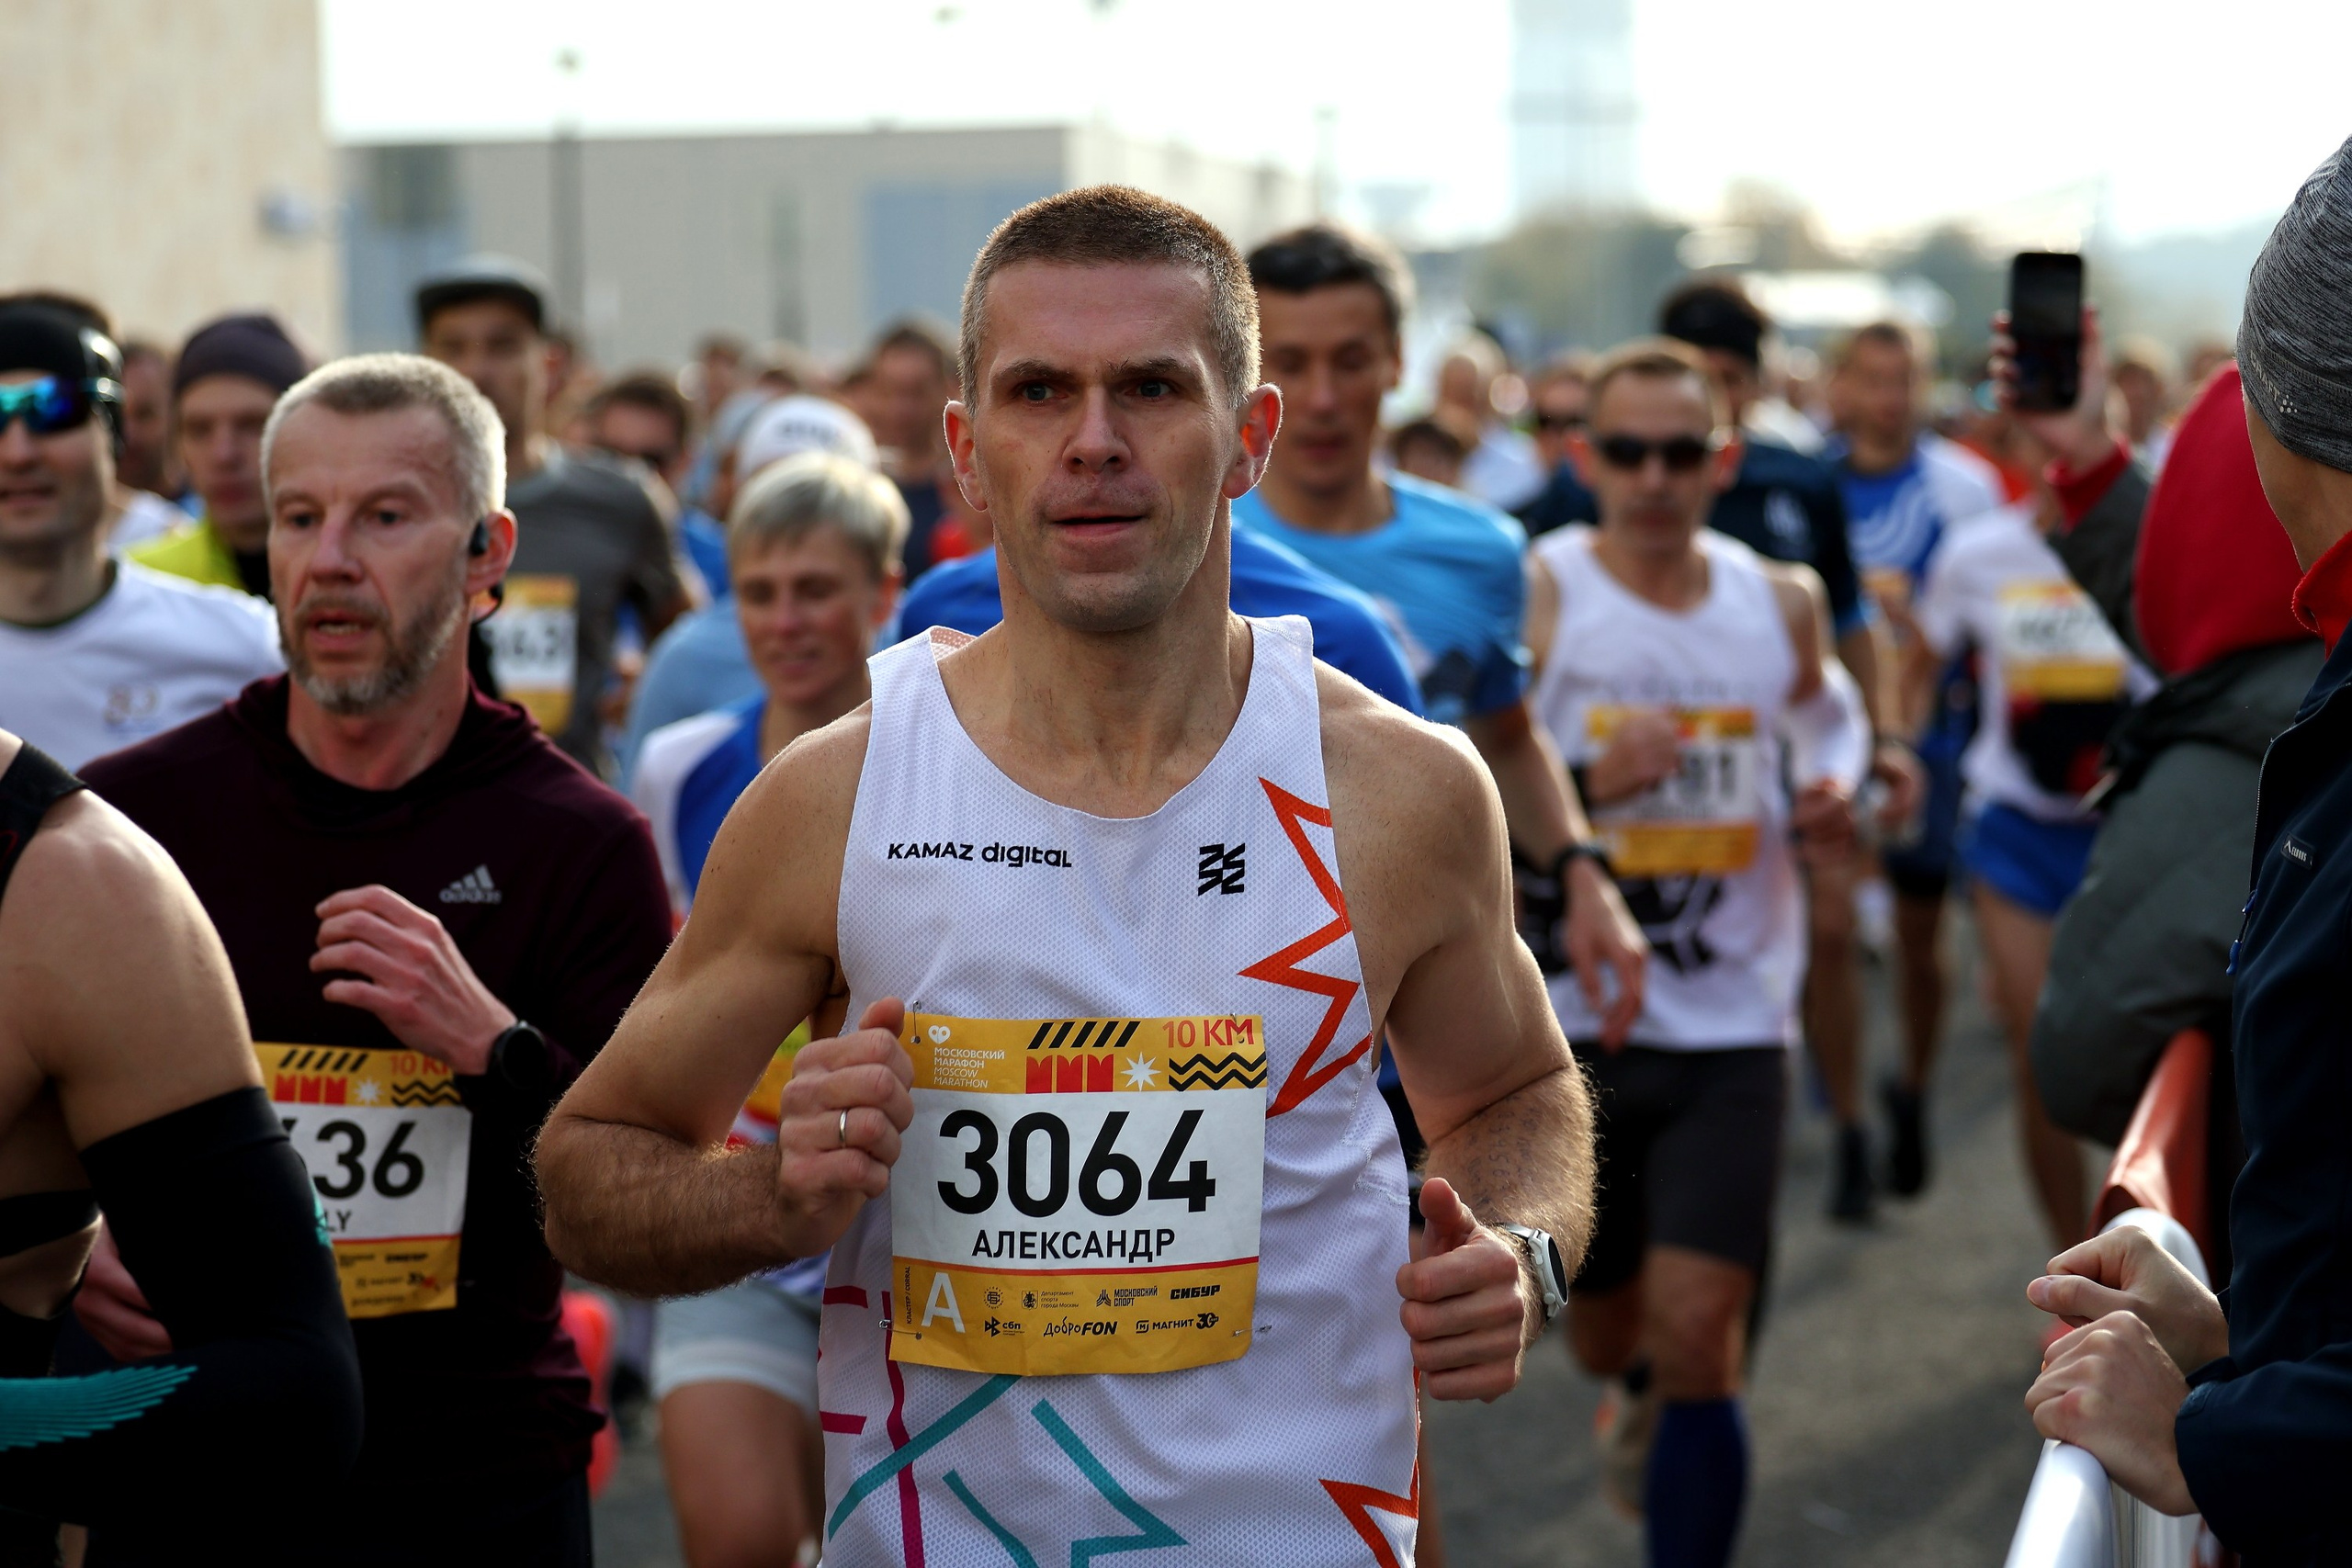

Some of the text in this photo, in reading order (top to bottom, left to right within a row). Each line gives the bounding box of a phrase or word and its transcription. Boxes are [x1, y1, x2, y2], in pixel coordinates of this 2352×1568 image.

[2250, 349, 2280, 402] CRAFT
[888, 841, 1072, 868] KAMAZ digital
[1162, 1020, 1196, 1048] 10
[934, 1046, 1005, 1060] МОСКОВСКИЙ
[389, 1054, 417, 1077] 10
[933, 1057, 985, 1068] МАРАФОН
[933, 1066, 978, 1078] MOSCOW
[933, 1077, 989, 1089] MARATHON
[281, 1118, 424, 1200] 36
[937, 1109, 1216, 1218] 3064
[971, 1228, 1176, 1263] АЛЕКСАНДР
[1114, 1285, 1158, 1298] МОСКОВСКИЙ
[1170, 1284, 1221, 1300] СИБУР
[1114, 1298, 1135, 1307] СПОРТ
[1002, 1321, 1021, 1329] сбп
[1152, 1318, 1194, 1330] МАГНИТ
